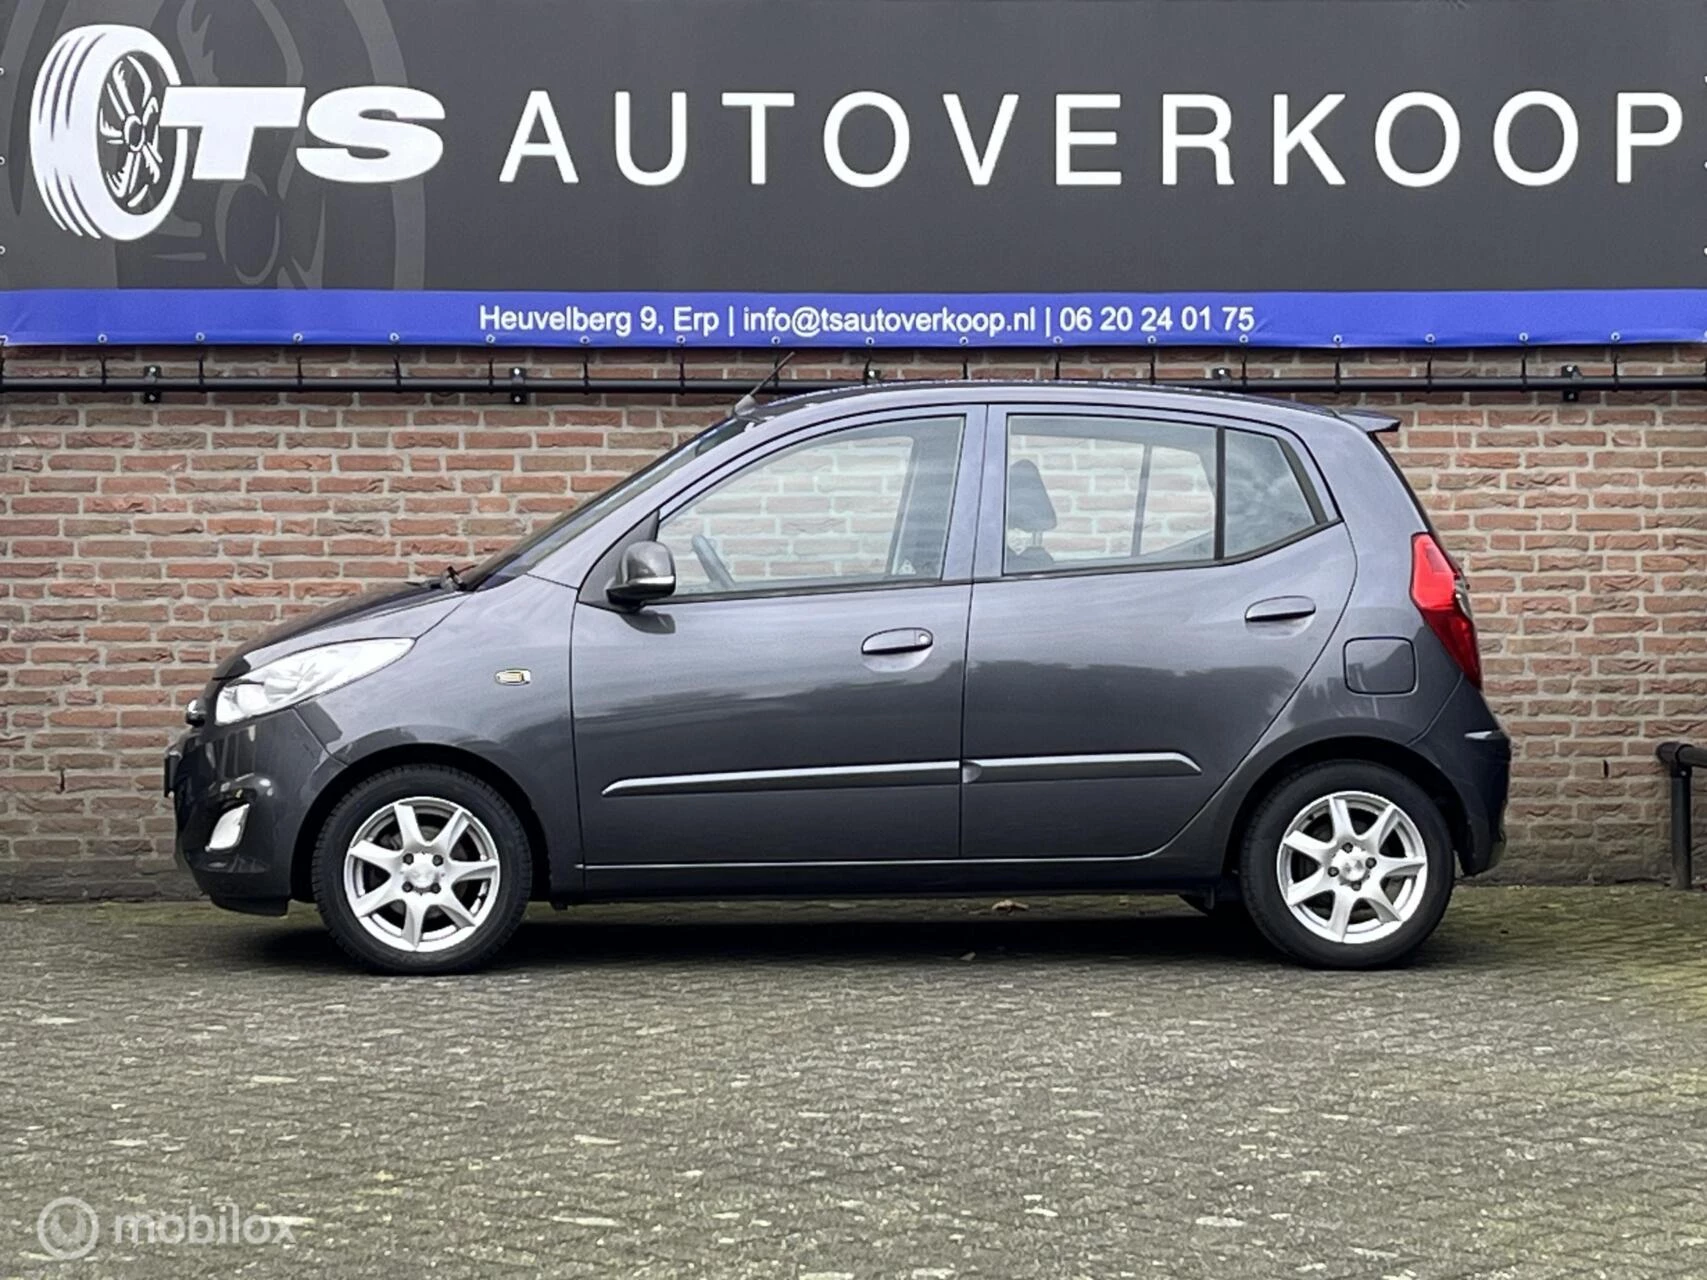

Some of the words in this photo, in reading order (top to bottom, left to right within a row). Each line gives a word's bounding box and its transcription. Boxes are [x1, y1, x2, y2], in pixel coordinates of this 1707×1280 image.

[159, 85, 446, 183] TS
[499, 90, 1682, 187] AUTOVERKOOP
[479, 305, 632, 337] Heuvelberg
[640, 306, 664, 333] 9,
[673, 306, 720, 335] Erp
[743, 306, 1036, 337] info@tsautoverkoop.nl
[1059, 306, 1093, 332] 06
[1099, 306, 1134, 332] 20
[1140, 306, 1173, 332] 24
[1181, 306, 1213, 332] 01
[1221, 306, 1255, 332] 75
